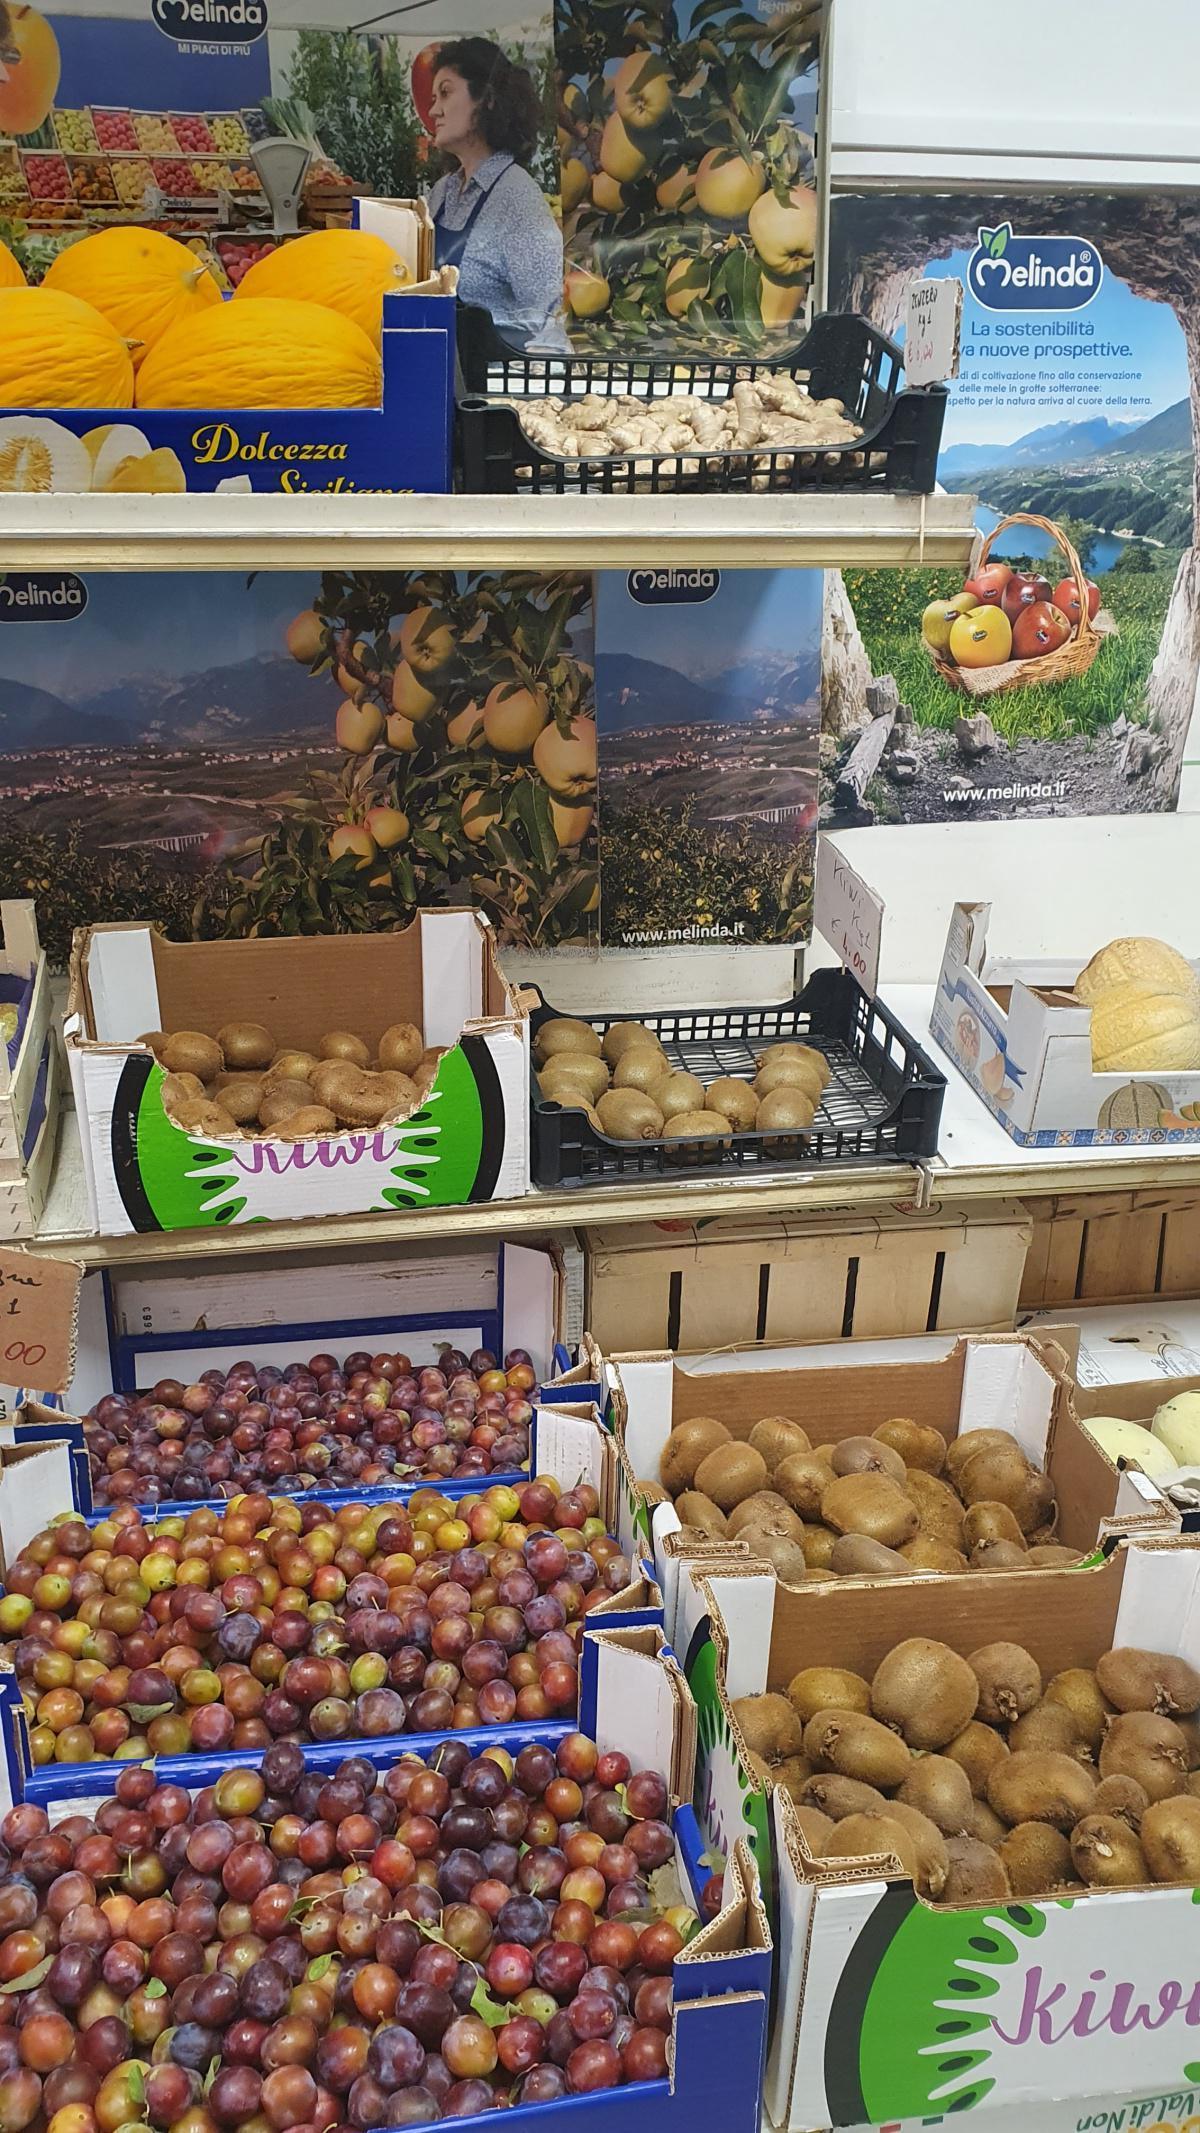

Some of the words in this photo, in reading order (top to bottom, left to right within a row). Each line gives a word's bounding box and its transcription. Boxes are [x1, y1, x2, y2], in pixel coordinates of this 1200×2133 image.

[178, 43, 190, 53] MI
[191, 44, 219, 55] PIACI
[221, 45, 232, 55] DI
[975, 253, 1094, 287] Melinda
[971, 321, 990, 336] La
[995, 321, 1095, 337] sostenibilità
[980, 345, 1029, 357] nuove
[1034, 342, 1133, 359] prospettive.
[971, 370, 979, 380] di
[982, 370, 1036, 381] coltivazione
[1039, 370, 1056, 381] fino
[1058, 370, 1075, 381] alla
[1077, 371, 1142, 381] conservazione
[959, 384, 981, 393] delle
[984, 384, 1006, 393] mele
[1009, 384, 1017, 393] in
[1020, 384, 1046, 395] grotte
[1049, 384, 1102, 393] sotterranee:
[978, 397, 993, 407] per
[995, 396, 1004, 406] la
[1006, 397, 1036, 406] natura
[1038, 396, 1064, 406] arriva
[1066, 396, 1075, 405] al
[1077, 397, 1103, 406] cuore
[1105, 396, 1127, 406] della
[1130, 396, 1152, 406] terra.
[191, 423, 349, 463] Dolcezza
[633, 569, 715, 589] Melinda
[943, 782, 1065, 801] www.melinda.it
[622, 922, 745, 942] www.melinda.it
[1130, 2101, 1155, 2128] di
[1158, 2093, 1194, 2122] Val
[1076, 2109, 1126, 2133] Non
